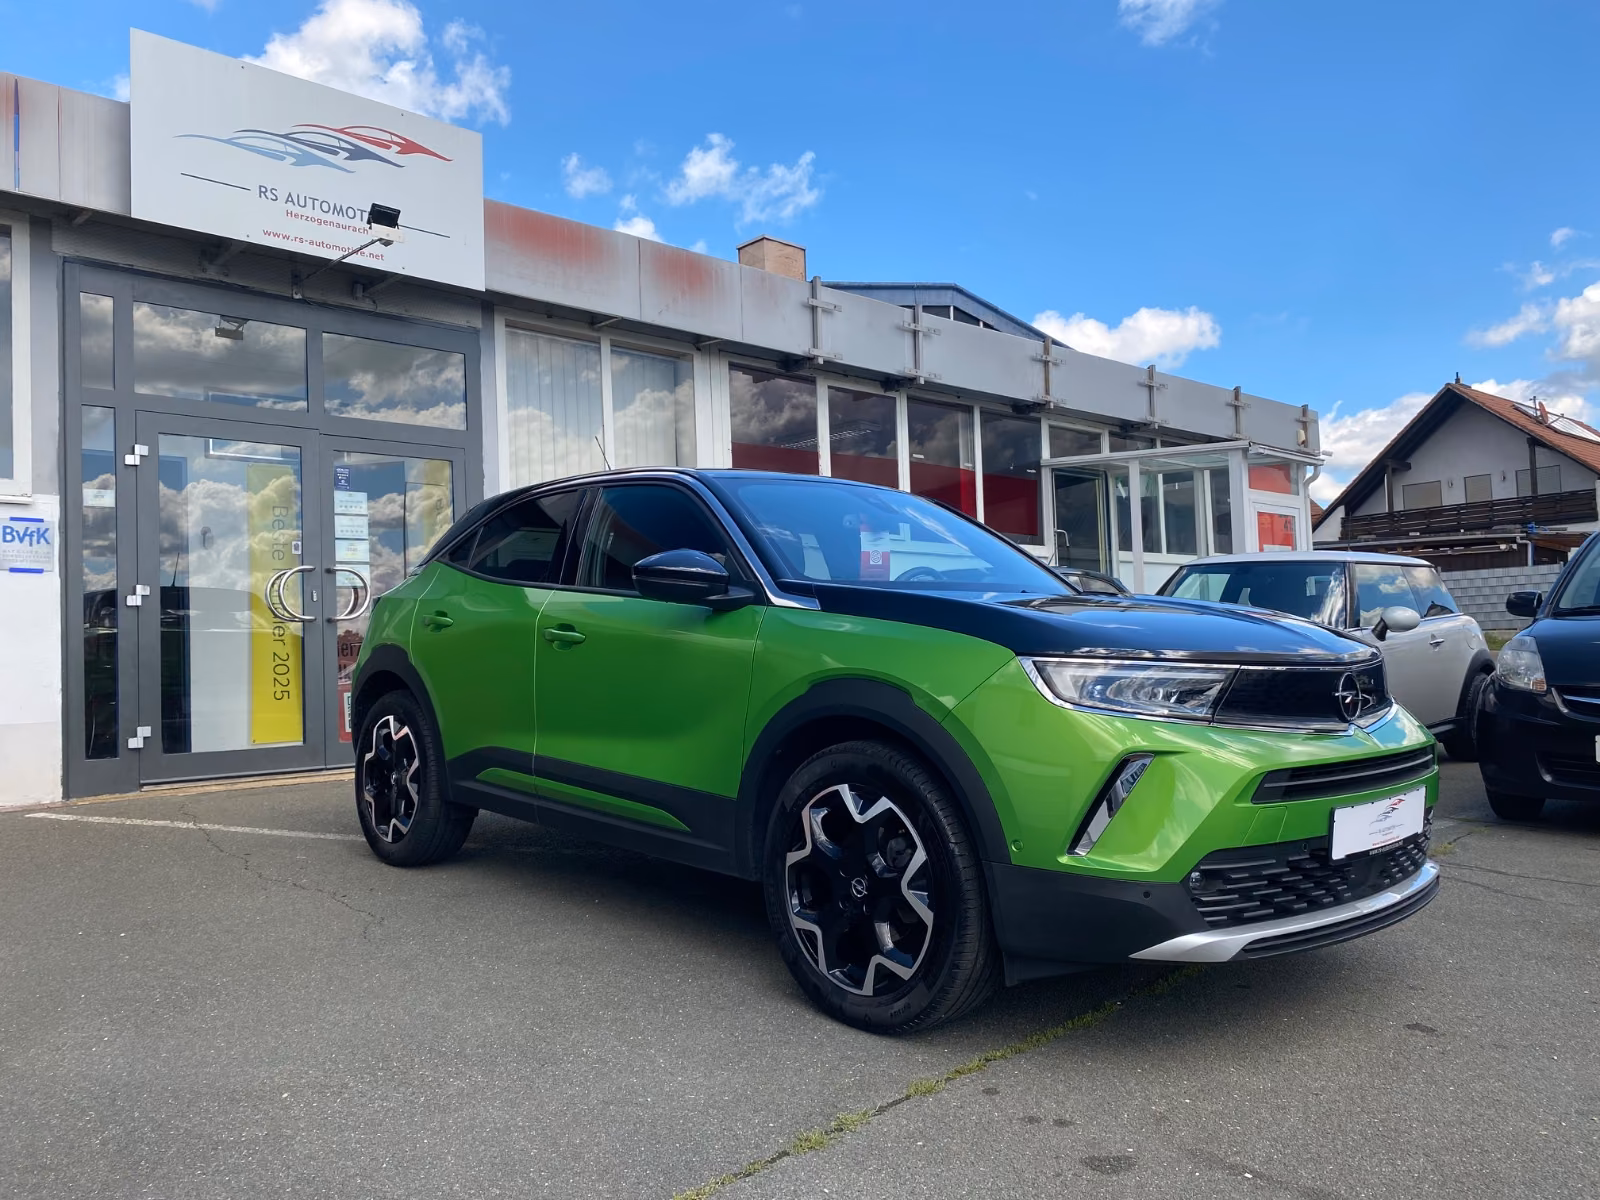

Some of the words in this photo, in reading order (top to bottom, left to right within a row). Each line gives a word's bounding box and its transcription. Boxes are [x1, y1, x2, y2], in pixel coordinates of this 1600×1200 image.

[258, 184, 279, 201] RS
[285, 192, 369, 222] AUTOMOT
[285, 209, 369, 235] Herzogenaurach
[272, 506, 288, 560] Beste
[273, 651, 290, 700] 2025
